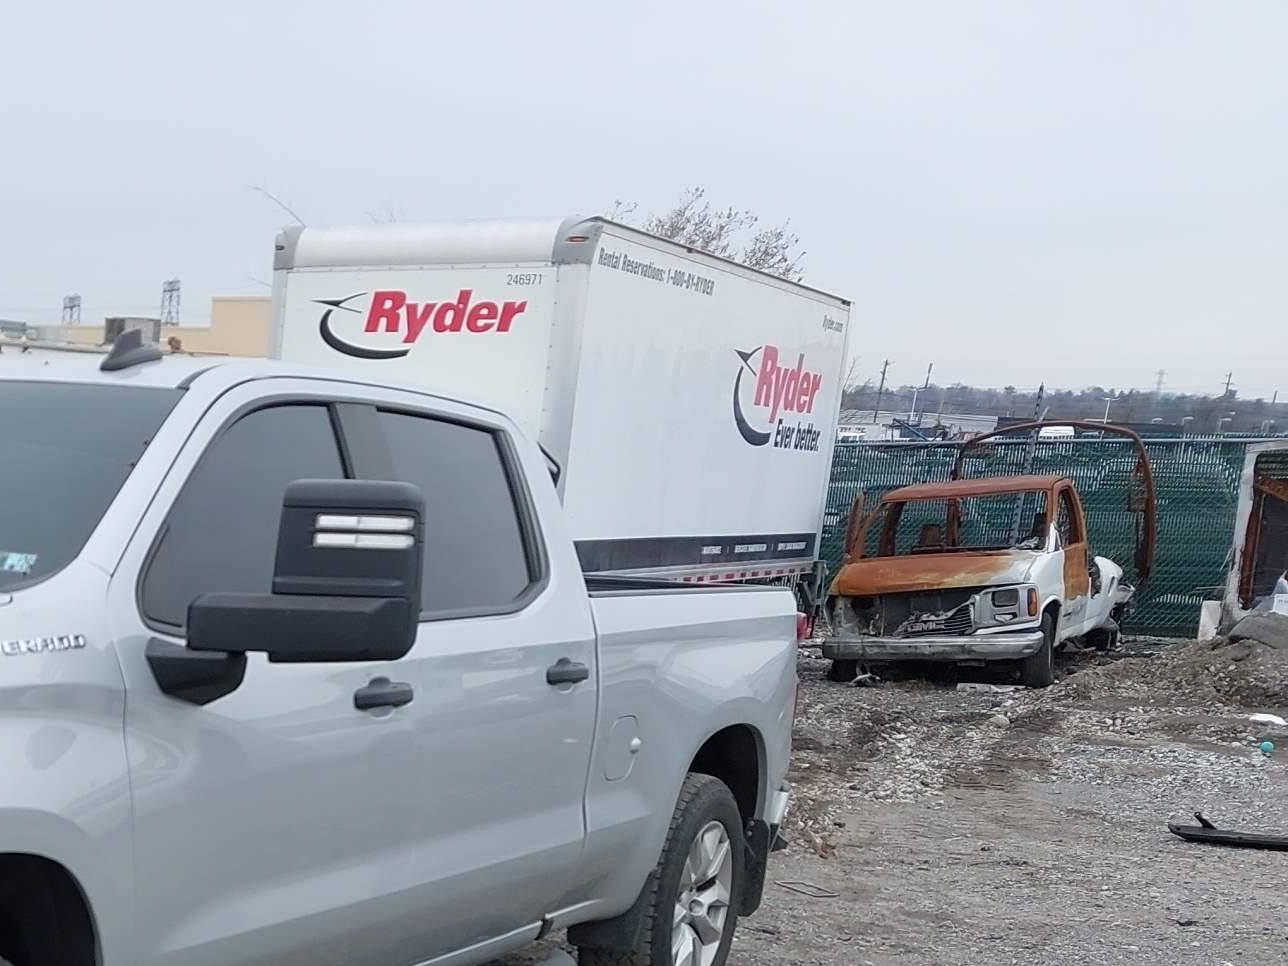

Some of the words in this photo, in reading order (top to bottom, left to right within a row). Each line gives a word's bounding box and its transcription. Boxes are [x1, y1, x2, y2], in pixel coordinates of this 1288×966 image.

[506, 273, 543, 286] 246971
[598, 248, 621, 269] Rental
[622, 253, 666, 282] Reservations:
[363, 289, 528, 344] Ryder
[753, 344, 823, 424] Ryder
[773, 418, 795, 449] Ever
[793, 421, 821, 452] better.
